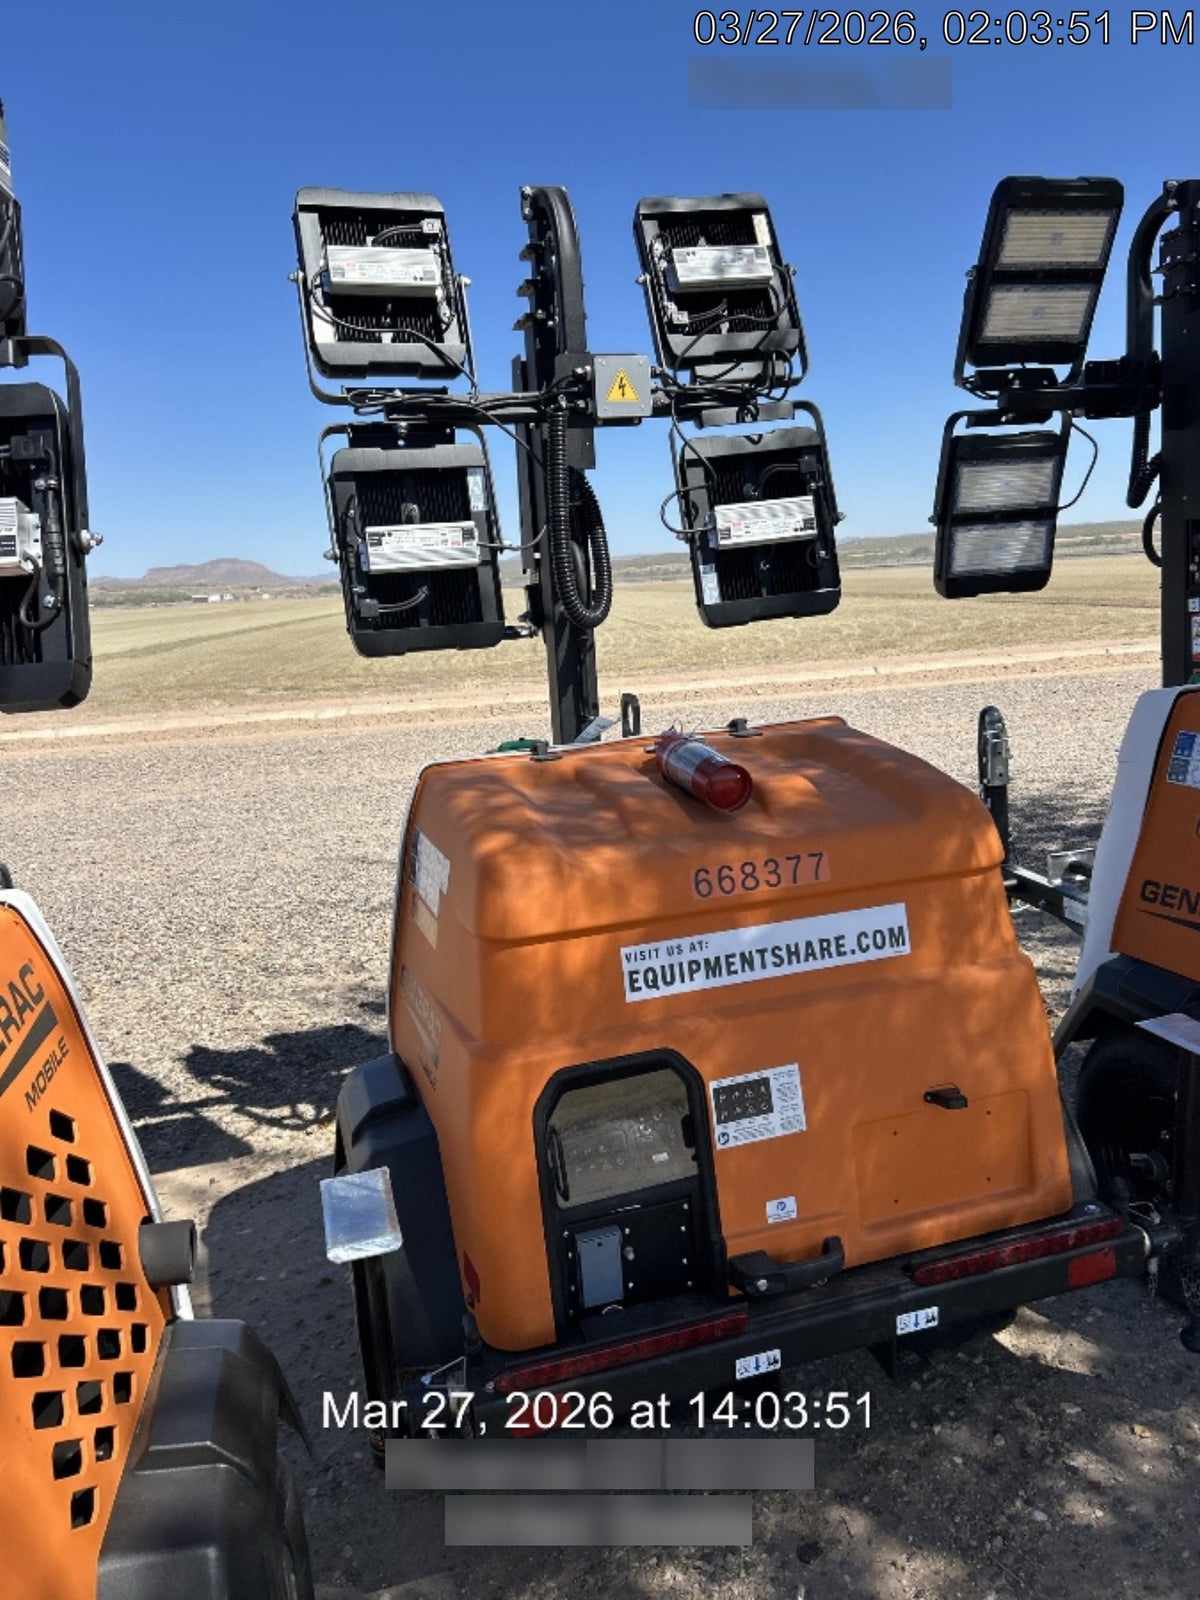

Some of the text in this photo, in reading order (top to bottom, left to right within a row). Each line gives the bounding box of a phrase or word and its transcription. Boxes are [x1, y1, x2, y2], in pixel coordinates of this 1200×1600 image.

[694, 852, 824, 898] 668377
[625, 939, 709, 964] VISIT US AT:
[627, 925, 907, 993] EQUIPMENTSHARE.COM
[0, 963, 45, 1056] RAC
[24, 1036, 70, 1112] MOBILE
